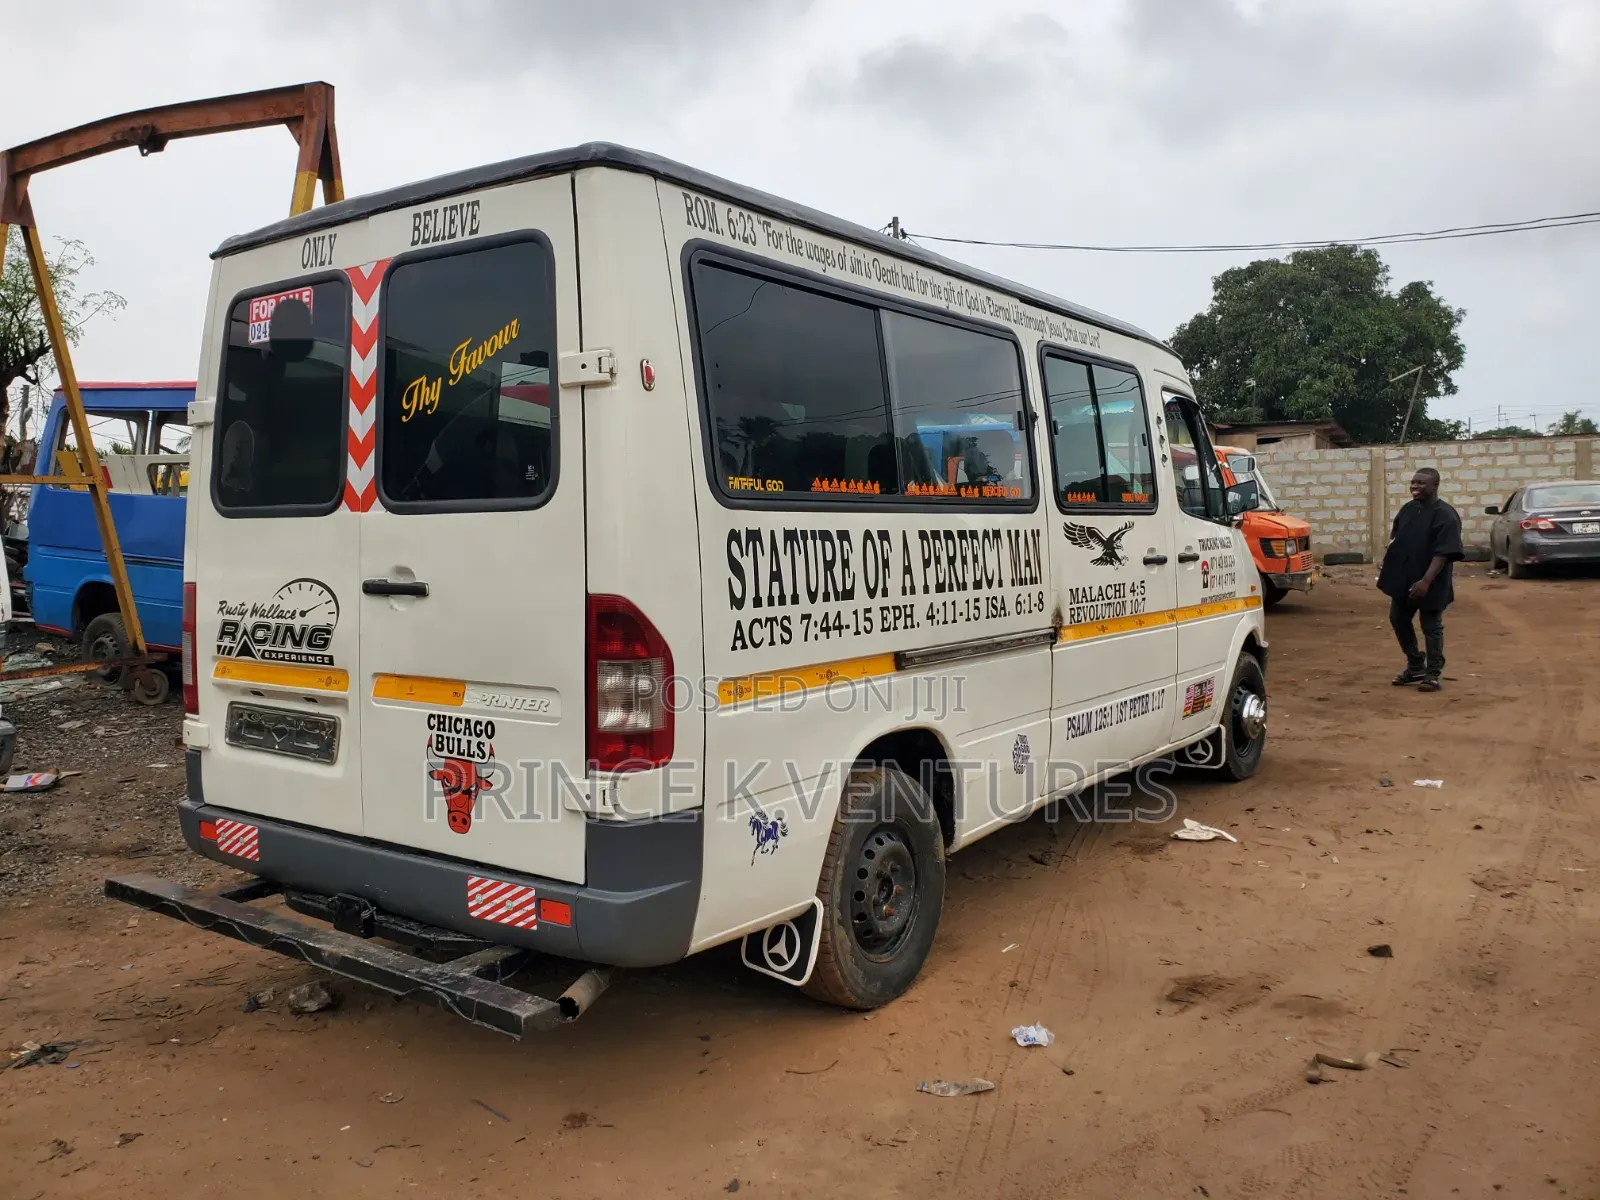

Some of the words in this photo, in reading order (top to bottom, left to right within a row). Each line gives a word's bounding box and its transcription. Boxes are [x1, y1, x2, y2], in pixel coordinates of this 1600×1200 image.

[301, 233, 337, 269] ONLY
[410, 200, 481, 247] BELIEVE
[682, 192, 725, 236] ROM.
[727, 207, 757, 247] 6:23
[786, 227, 804, 257] the
[805, 240, 836, 273] wages
[837, 246, 847, 272] of
[850, 250, 863, 278] sin
[864, 253, 872, 280] is
[872, 257, 901, 288] Death
[901, 265, 916, 293] but
[916, 271, 929, 297] for
[929, 276, 943, 300] the
[943, 281, 957, 309] gift
[957, 285, 964, 307] of
[965, 288, 979, 315] God
[979, 292, 986, 313] is
[252, 298, 276, 321] FOR
[250, 321, 272, 341] 024
[402, 375, 442, 422] Thy
[448, 318, 521, 386] Favour
[728, 476, 765, 491] FAITHFUL
[766, 479, 784, 492] GOD
[726, 527, 856, 611] STATURE
[862, 528, 893, 600] OF
[901, 529, 917, 596] A
[918, 527, 1004, 595] PERFECT
[1007, 528, 1043, 588] MAN
[1069, 582, 1126, 605] MALACHI
[1129, 580, 1146, 596] 4:5
[217, 600, 249, 622] Rusty
[250, 602, 298, 620] Wallace
[731, 615, 793, 651] ACTS
[800, 607, 874, 643] 7:44-15
[879, 603, 920, 632] EPH.
[926, 597, 981, 626] 4:11-15
[985, 595, 1011, 619] ISA.
[1015, 591, 1045, 615] 6:1-8
[1069, 600, 1127, 624] REVOLUTION
[1129, 597, 1146, 614] 10:7
[216, 618, 335, 654] RACING
[264, 651, 330, 664] EXPERIENCE
[464, 688, 552, 713] SPRINTER
[427, 713, 496, 740] CHICAGO
[1066, 711, 1093, 741] PSALM
[1095, 705, 1113, 732] 125:1
[1115, 700, 1128, 725] 1ST
[1129, 693, 1150, 720] PETER
[1151, 688, 1165, 711] 1:17
[435, 734, 487, 760] BULLS
